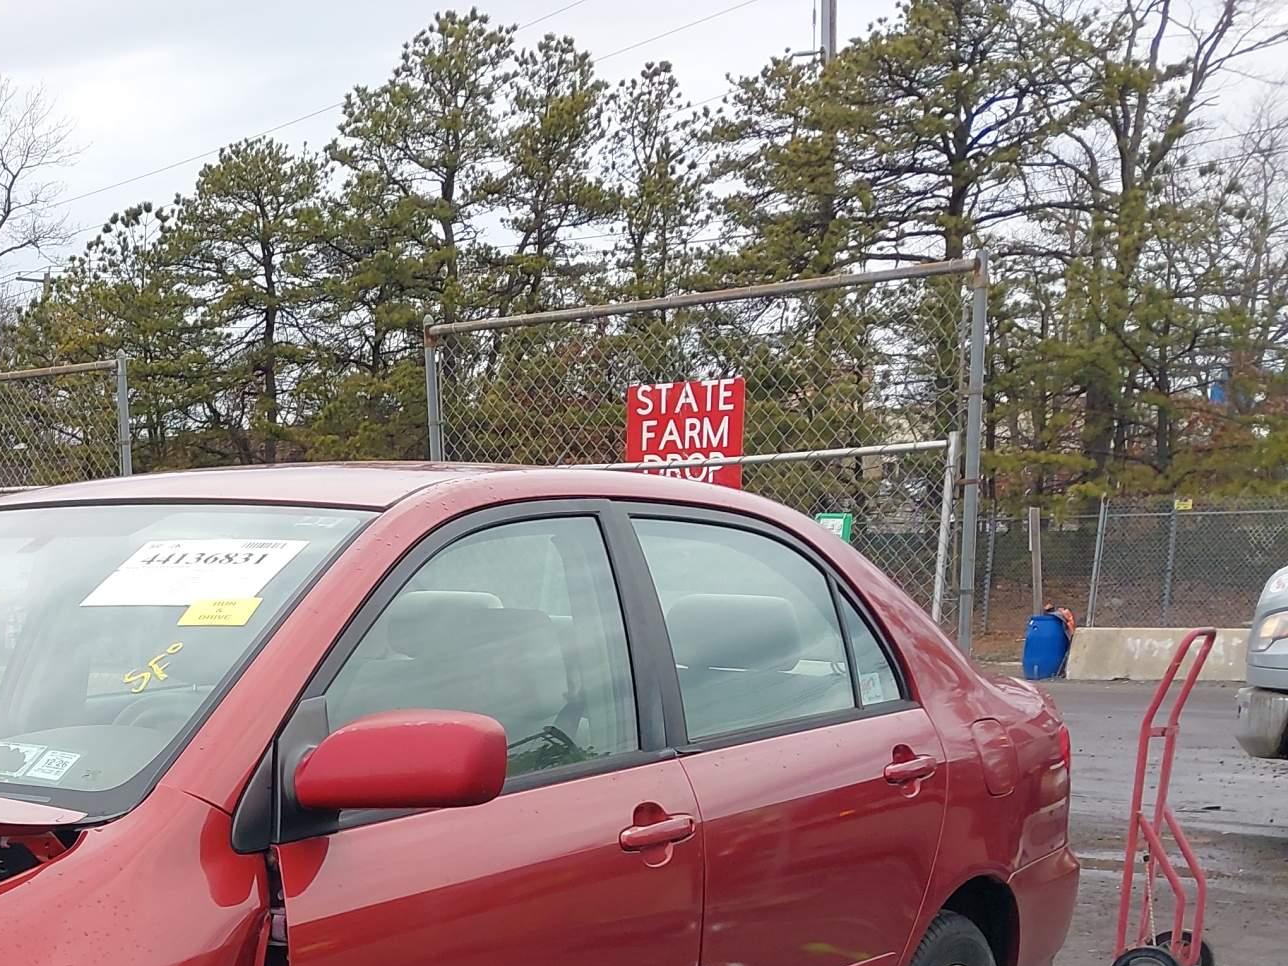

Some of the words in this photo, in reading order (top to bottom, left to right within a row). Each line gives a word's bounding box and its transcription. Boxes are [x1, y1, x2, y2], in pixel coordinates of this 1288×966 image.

[636, 379, 734, 415] STATE
[641, 416, 728, 451] FARM
[141, 552, 268, 565] 44136831
